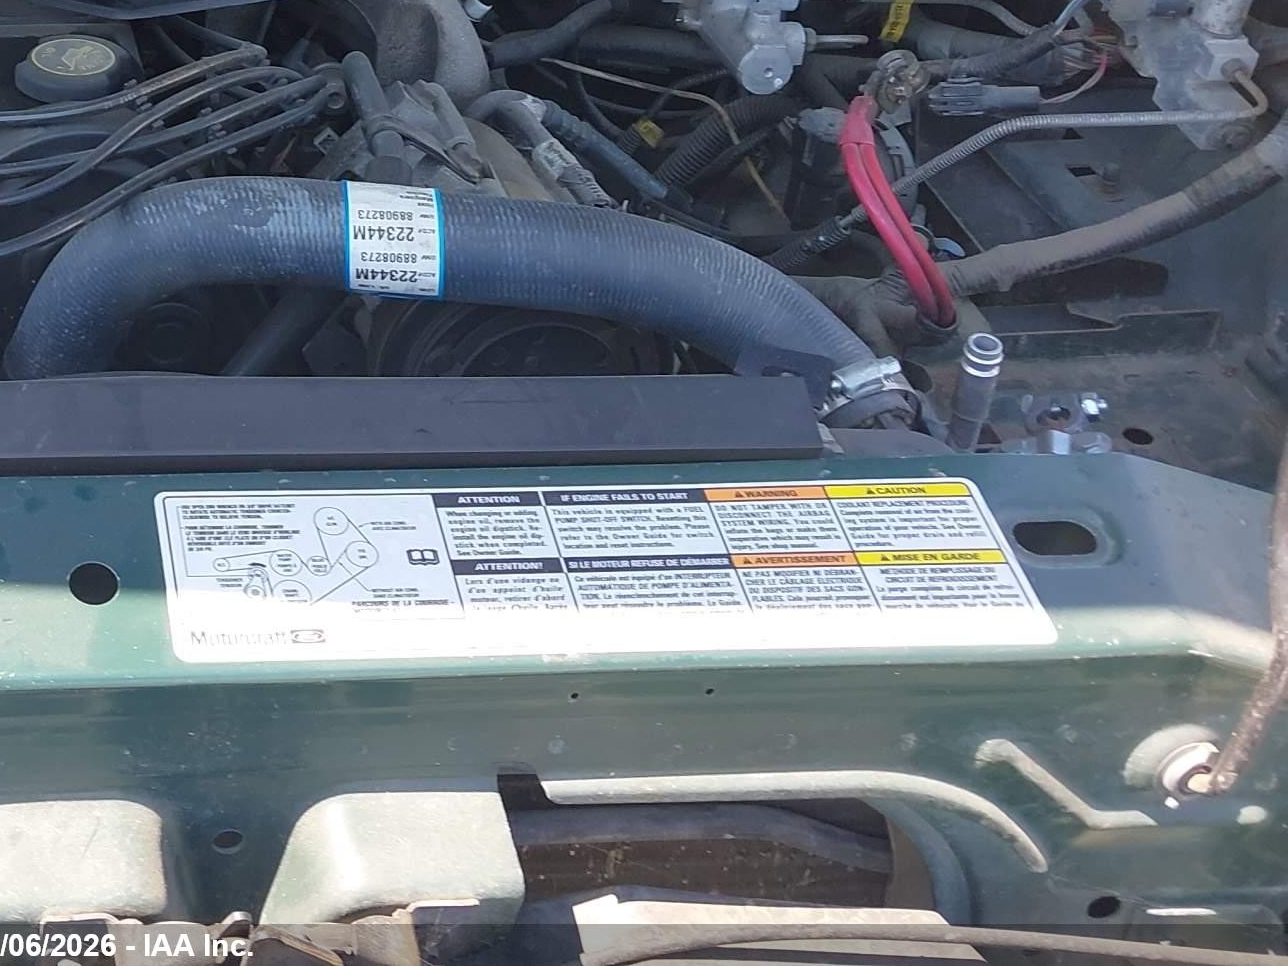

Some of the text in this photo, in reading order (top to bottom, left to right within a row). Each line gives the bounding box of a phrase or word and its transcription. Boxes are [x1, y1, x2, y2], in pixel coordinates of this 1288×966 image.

[358, 210, 414, 221] 88908273
[353, 225, 415, 241] 22344M
[361, 252, 417, 263] 88908273
[356, 268, 418, 282] 22344M
[612, 493, 640, 501] FAILS
[658, 492, 689, 500] START
[680, 557, 730, 566] DÉMARRER
[755, 556, 848, 564] AVERTISSEMENT
[475, 562, 544, 570] ATTENTION!
